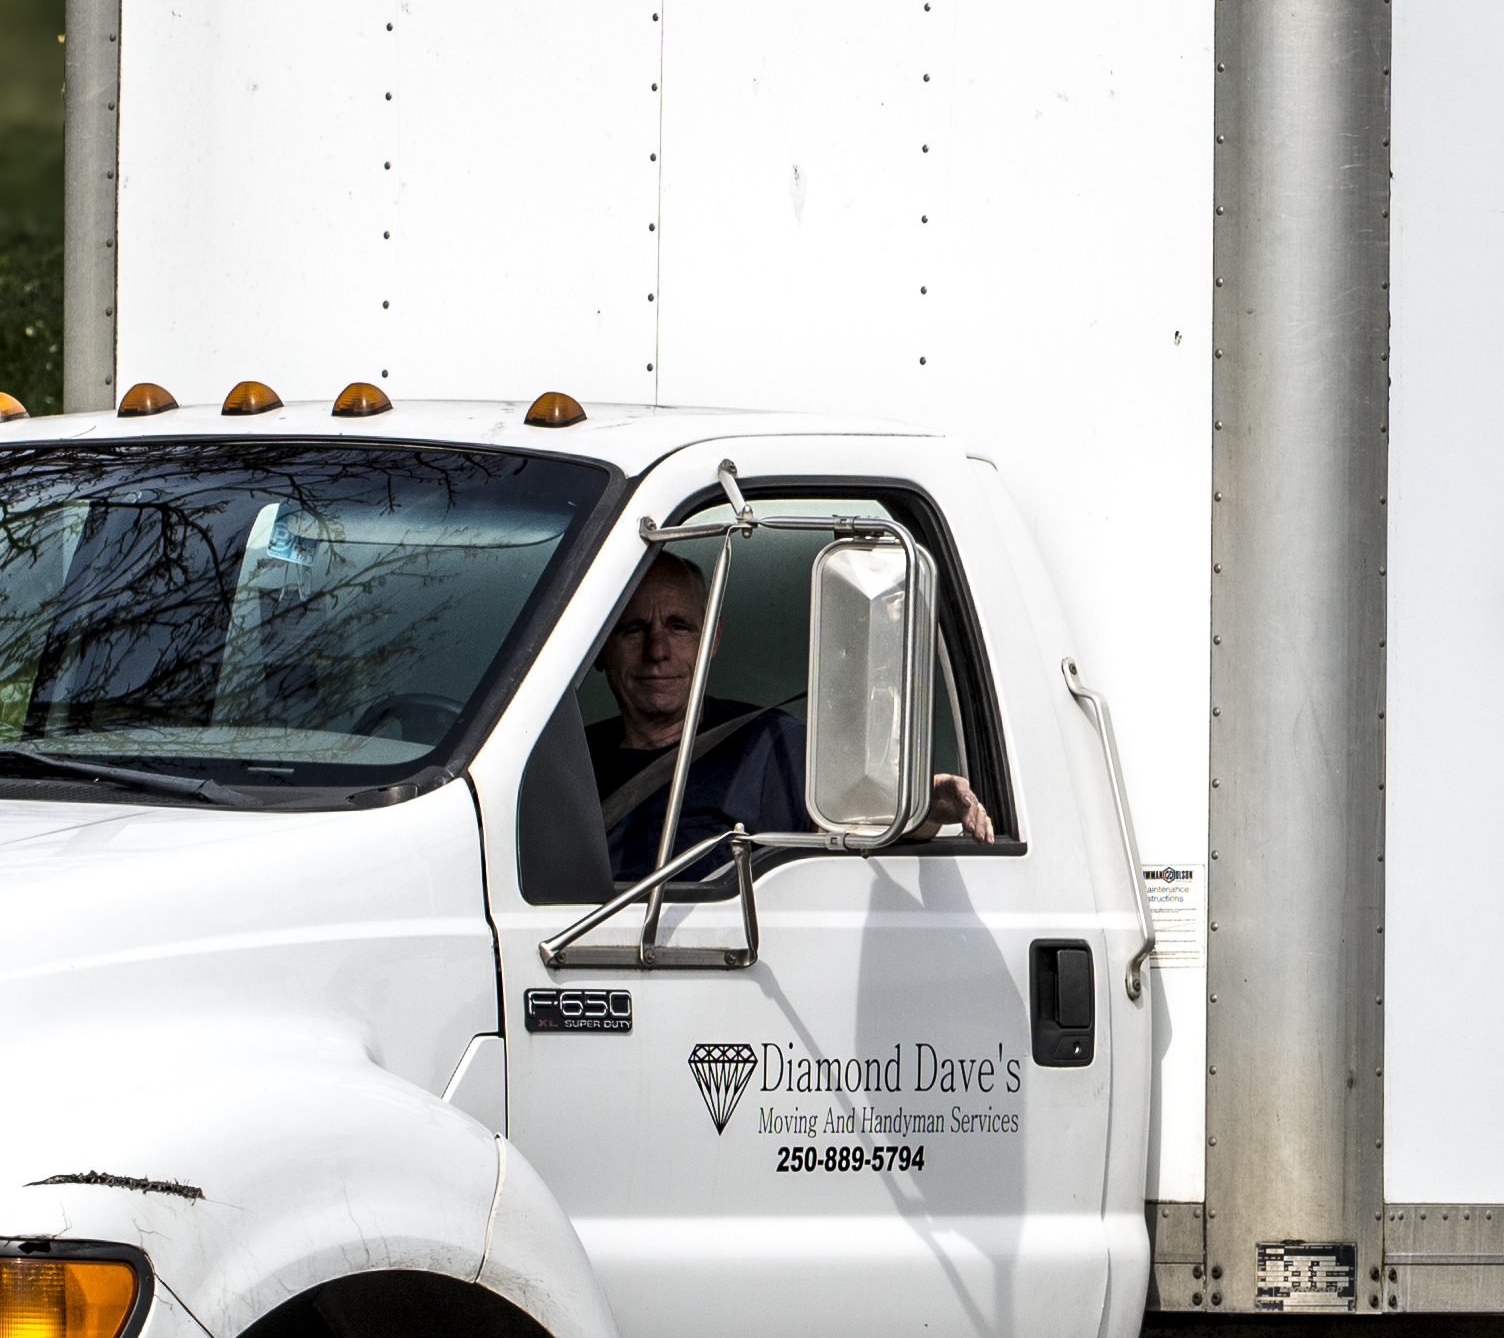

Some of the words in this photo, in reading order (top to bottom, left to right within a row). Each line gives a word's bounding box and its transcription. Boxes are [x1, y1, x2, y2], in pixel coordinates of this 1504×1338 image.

[538, 1019, 558, 1027] XL
[564, 1019, 601, 1029] SUPER
[603, 1020, 632, 1029] DUTY
[760, 1043, 902, 1092] Diamond
[914, 1043, 1021, 1093] Dave's
[758, 1107, 817, 1138] Moving
[823, 1107, 856, 1134] And
[861, 1107, 945, 1137] Handyman
[950, 1106, 1019, 1133] Services
[776, 1145, 925, 1173] 250-889-5794
